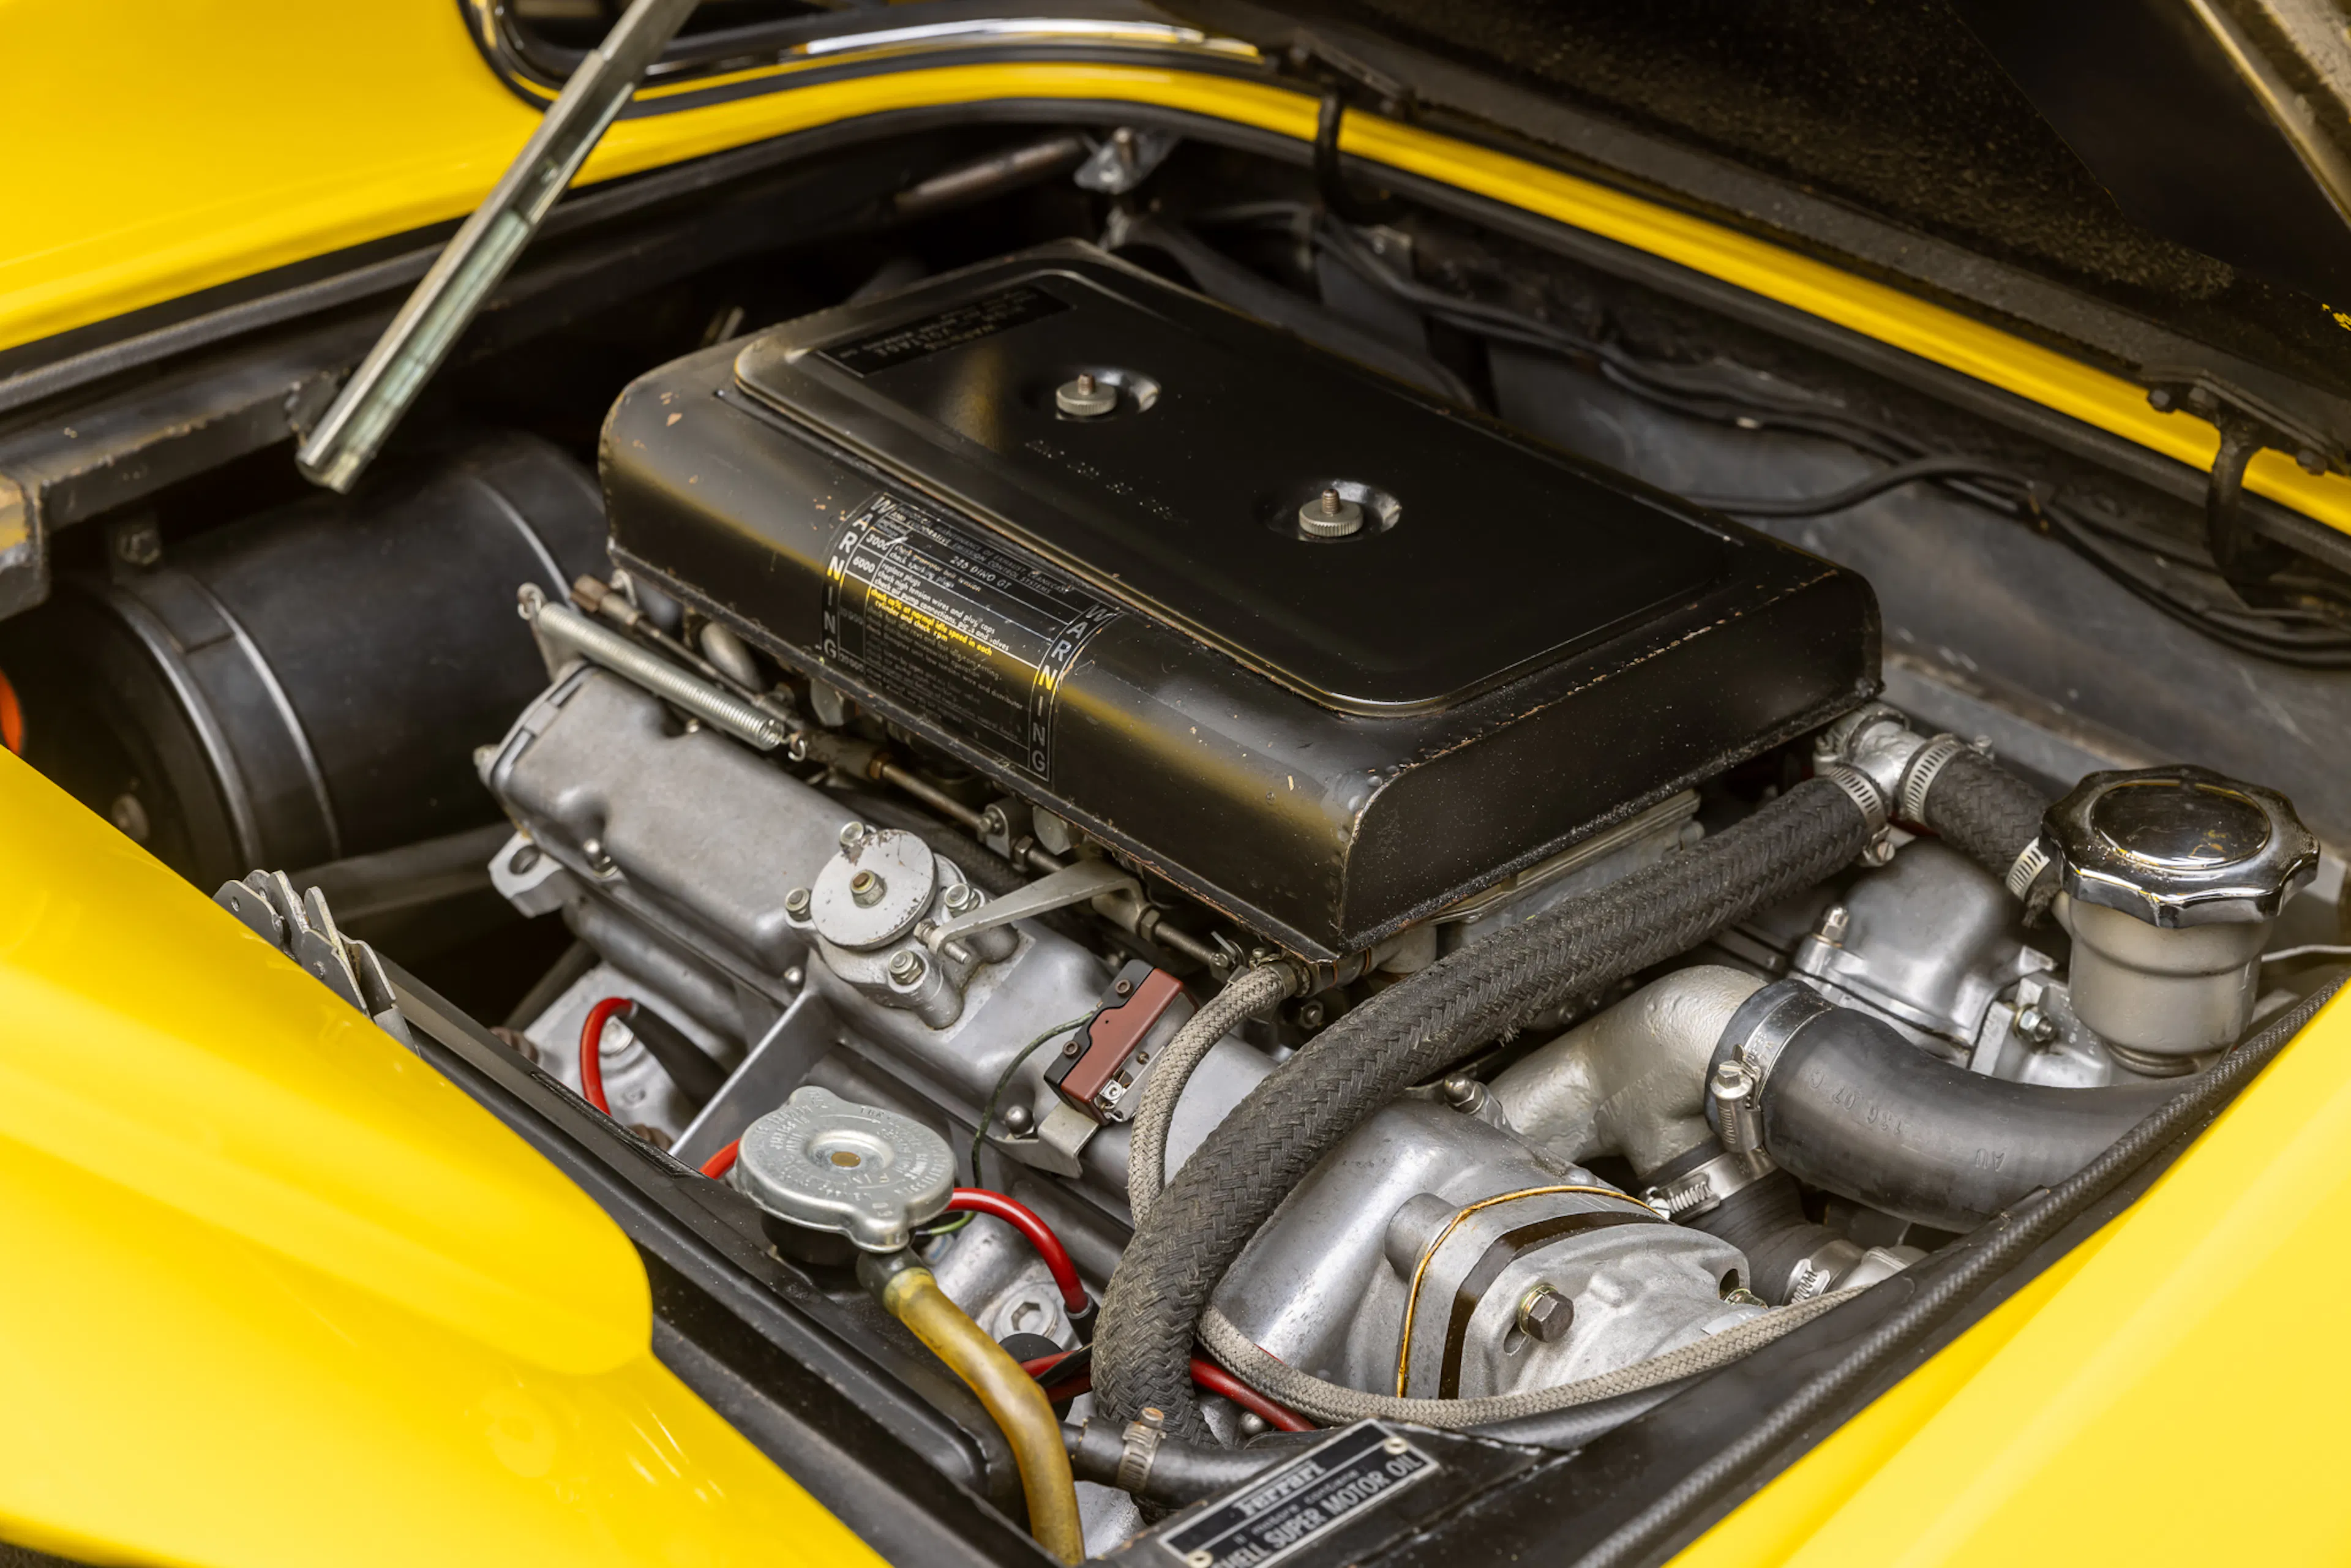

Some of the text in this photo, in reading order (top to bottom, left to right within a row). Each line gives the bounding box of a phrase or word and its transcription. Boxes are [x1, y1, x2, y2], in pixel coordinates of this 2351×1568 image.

[823, 496, 896, 658] WARNING
[852, 554, 876, 575] 6000
[881, 561, 921, 590] replace plugs
[889, 550, 908, 565] check
[969, 564, 997, 583] DINO
[996, 577, 1013, 591] GT
[1020, 576, 1052, 595] SYSTEMS
[870, 586, 888, 604] check
[911, 607, 936, 628] normal
[934, 619, 948, 634] idle
[948, 626, 969, 647] speed
[968, 636, 977, 649] in
[976, 640, 992, 657] each
[873, 575, 892, 591] check
[975, 628, 991, 642] and
[877, 568, 896, 584] check
[909, 584, 931, 602] tension
[931, 596, 950, 612] wires
[950, 604, 966, 620] and
[980, 623, 996, 637] caps
[899, 610, 913, 626] and
[912, 616, 931, 634] check
[1031, 604, 1117, 772] WARNING
[1212, 1453, 1424, 1568] HELL SUPER MOTOR OIL
[1231, 1458, 1328, 1520] Ferrari
